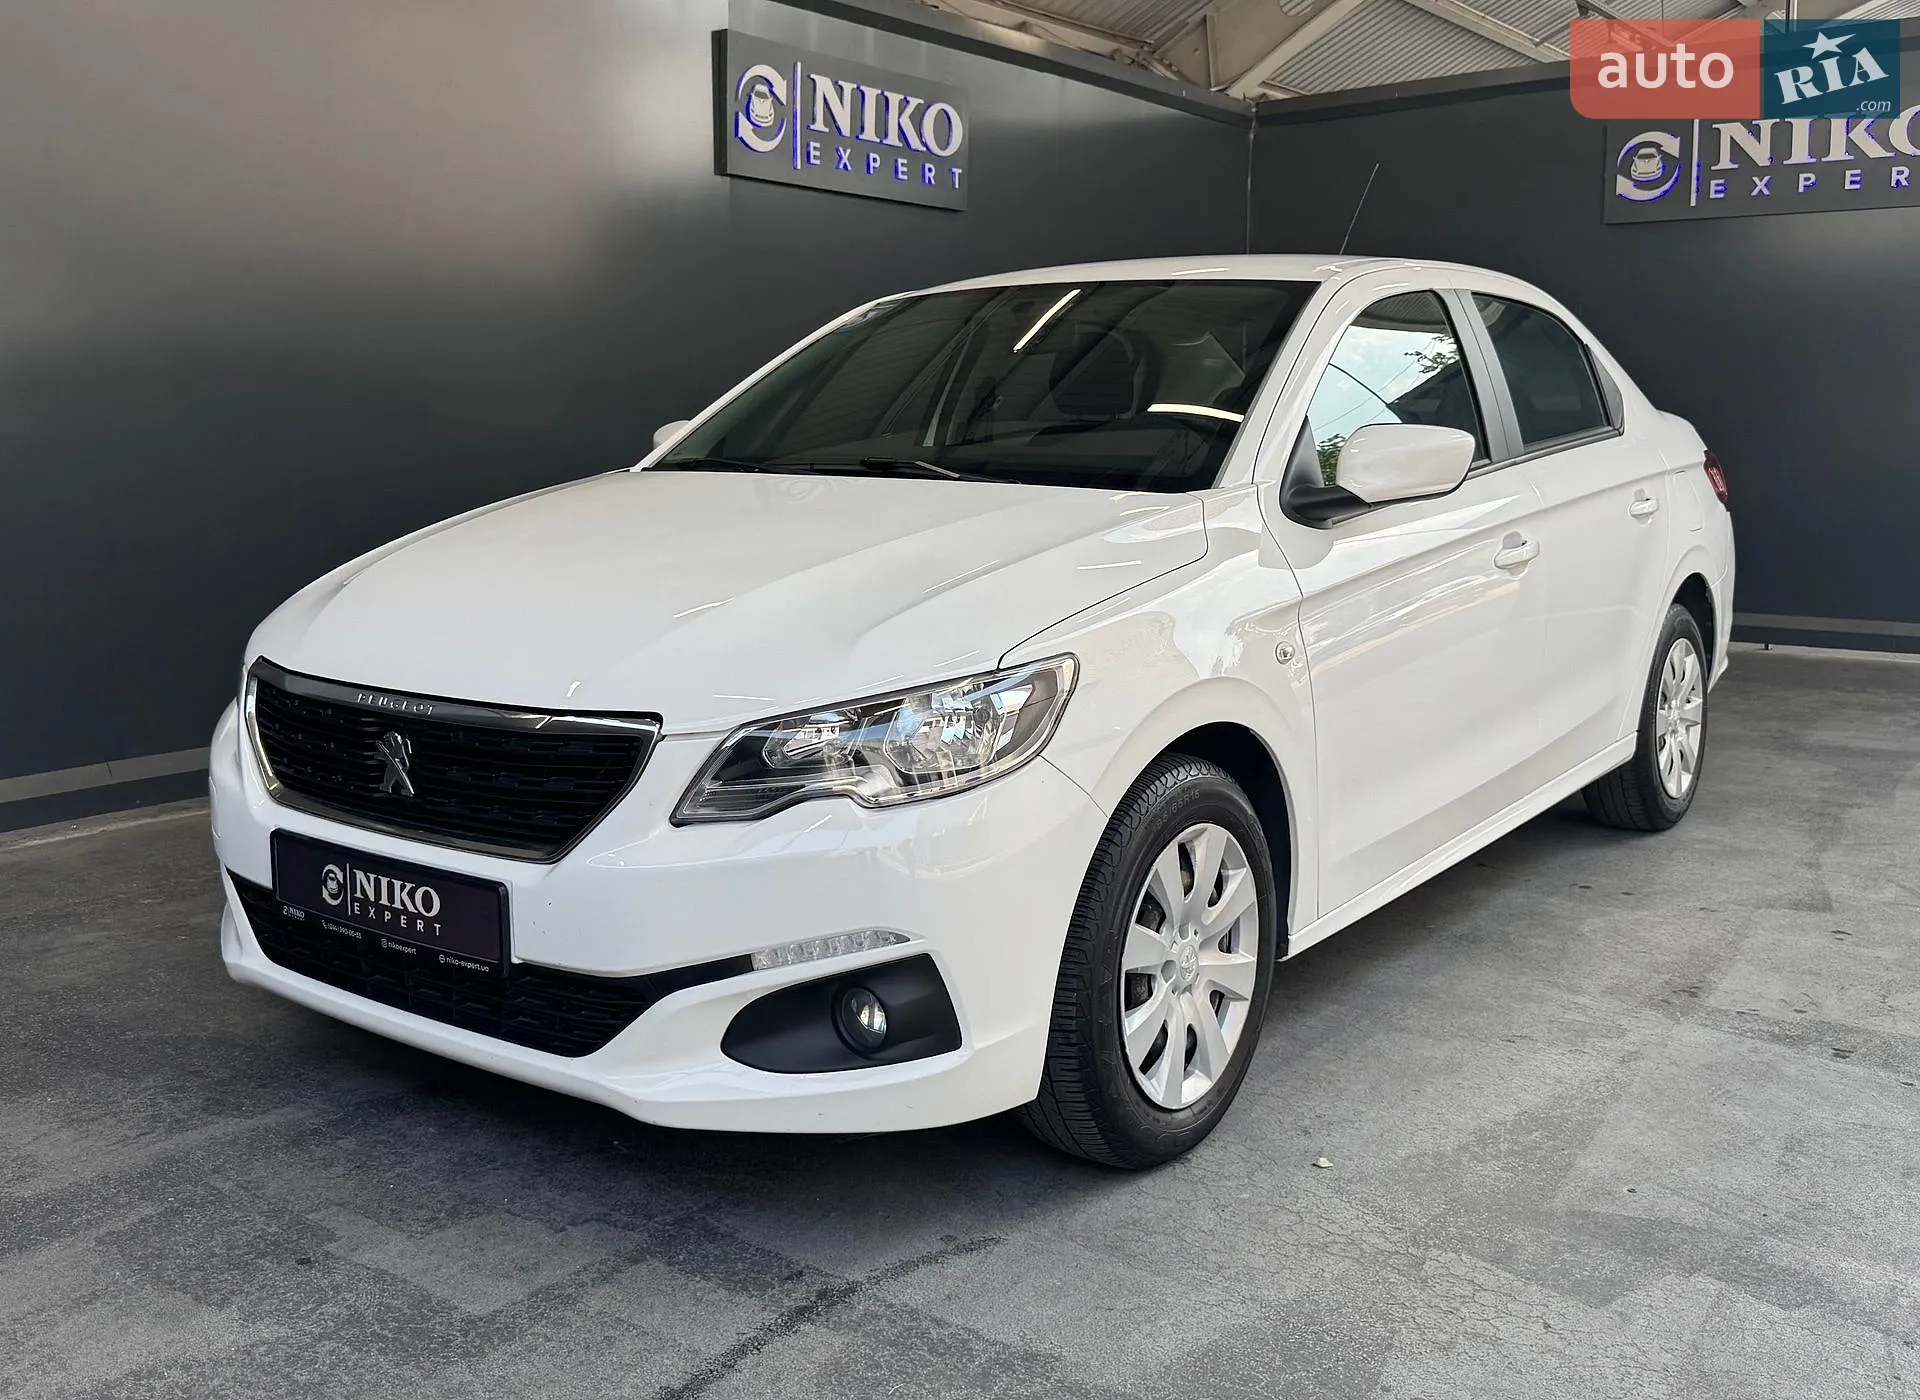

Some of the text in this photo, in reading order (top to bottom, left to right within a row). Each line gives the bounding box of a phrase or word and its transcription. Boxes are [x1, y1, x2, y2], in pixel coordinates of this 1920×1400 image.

[807, 73, 963, 157] NIKO
[806, 141, 962, 189] EXPERT
[1709, 165, 1911, 199] EXPER
[353, 868, 441, 917] NIKO
[354, 901, 441, 937] EXPERT
[388, 941, 417, 955] nikoexpert
